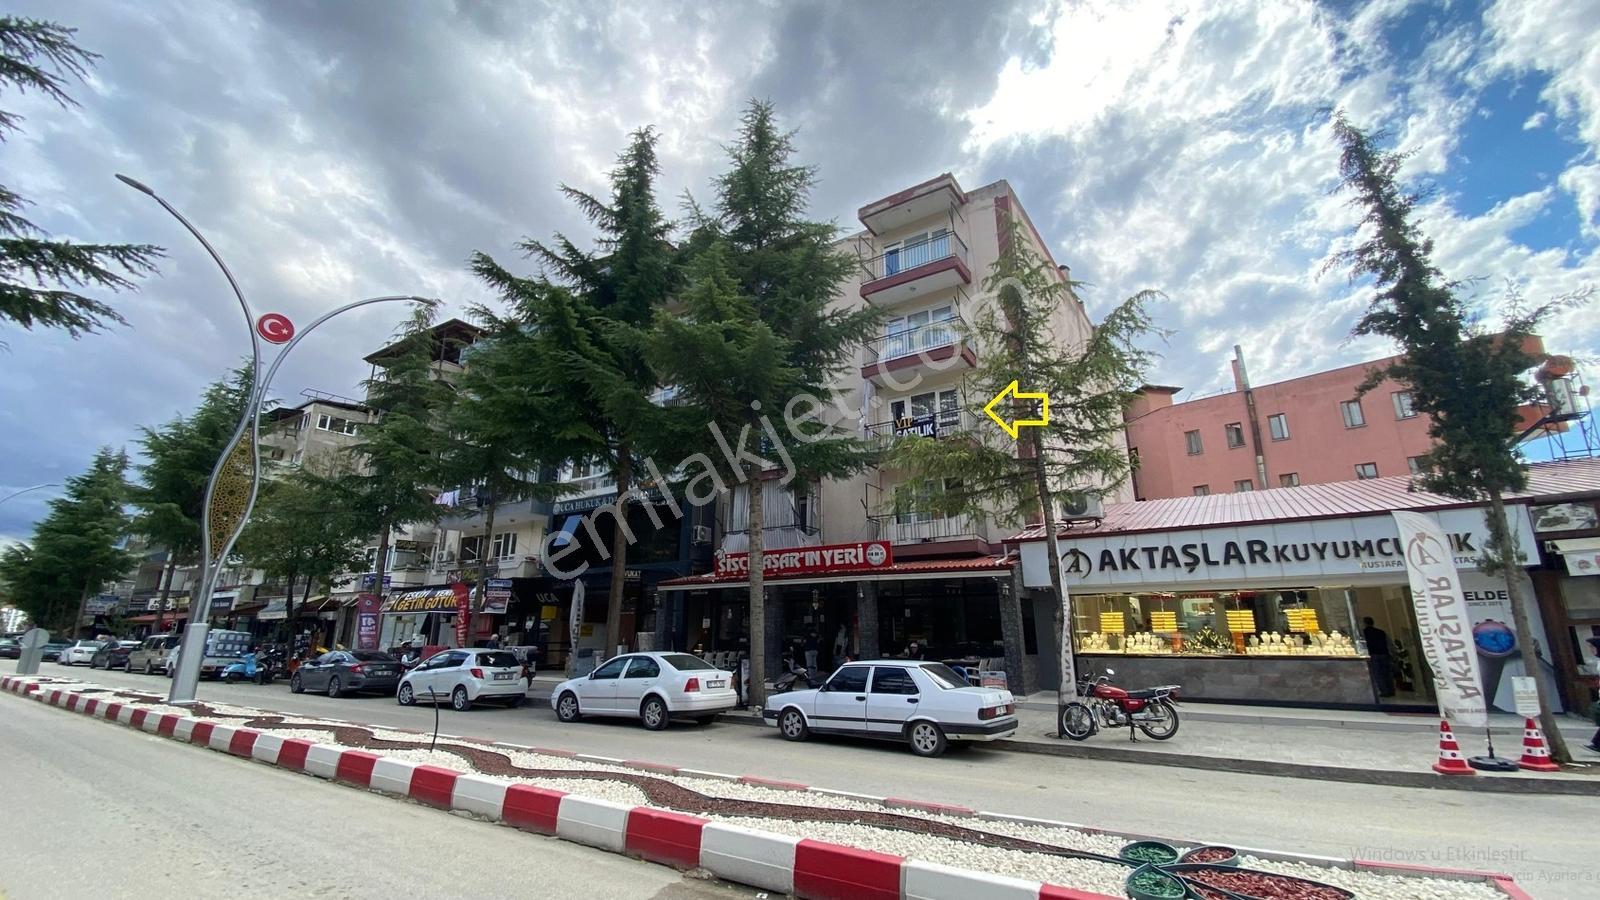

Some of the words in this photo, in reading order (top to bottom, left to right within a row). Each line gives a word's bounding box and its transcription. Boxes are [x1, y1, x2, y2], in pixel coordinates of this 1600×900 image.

[895, 416, 913, 429] VIP
[896, 423, 934, 438] SATILIK
[763, 550, 821, 573] AŞAR'IN
[822, 543, 864, 567] YERİ
[1099, 539, 1271, 574] AKTAŞLAR
[1273, 532, 1477, 563] KUYUMCUK
[536, 592, 560, 603] UCA
[1463, 590, 1508, 601] ELDE
